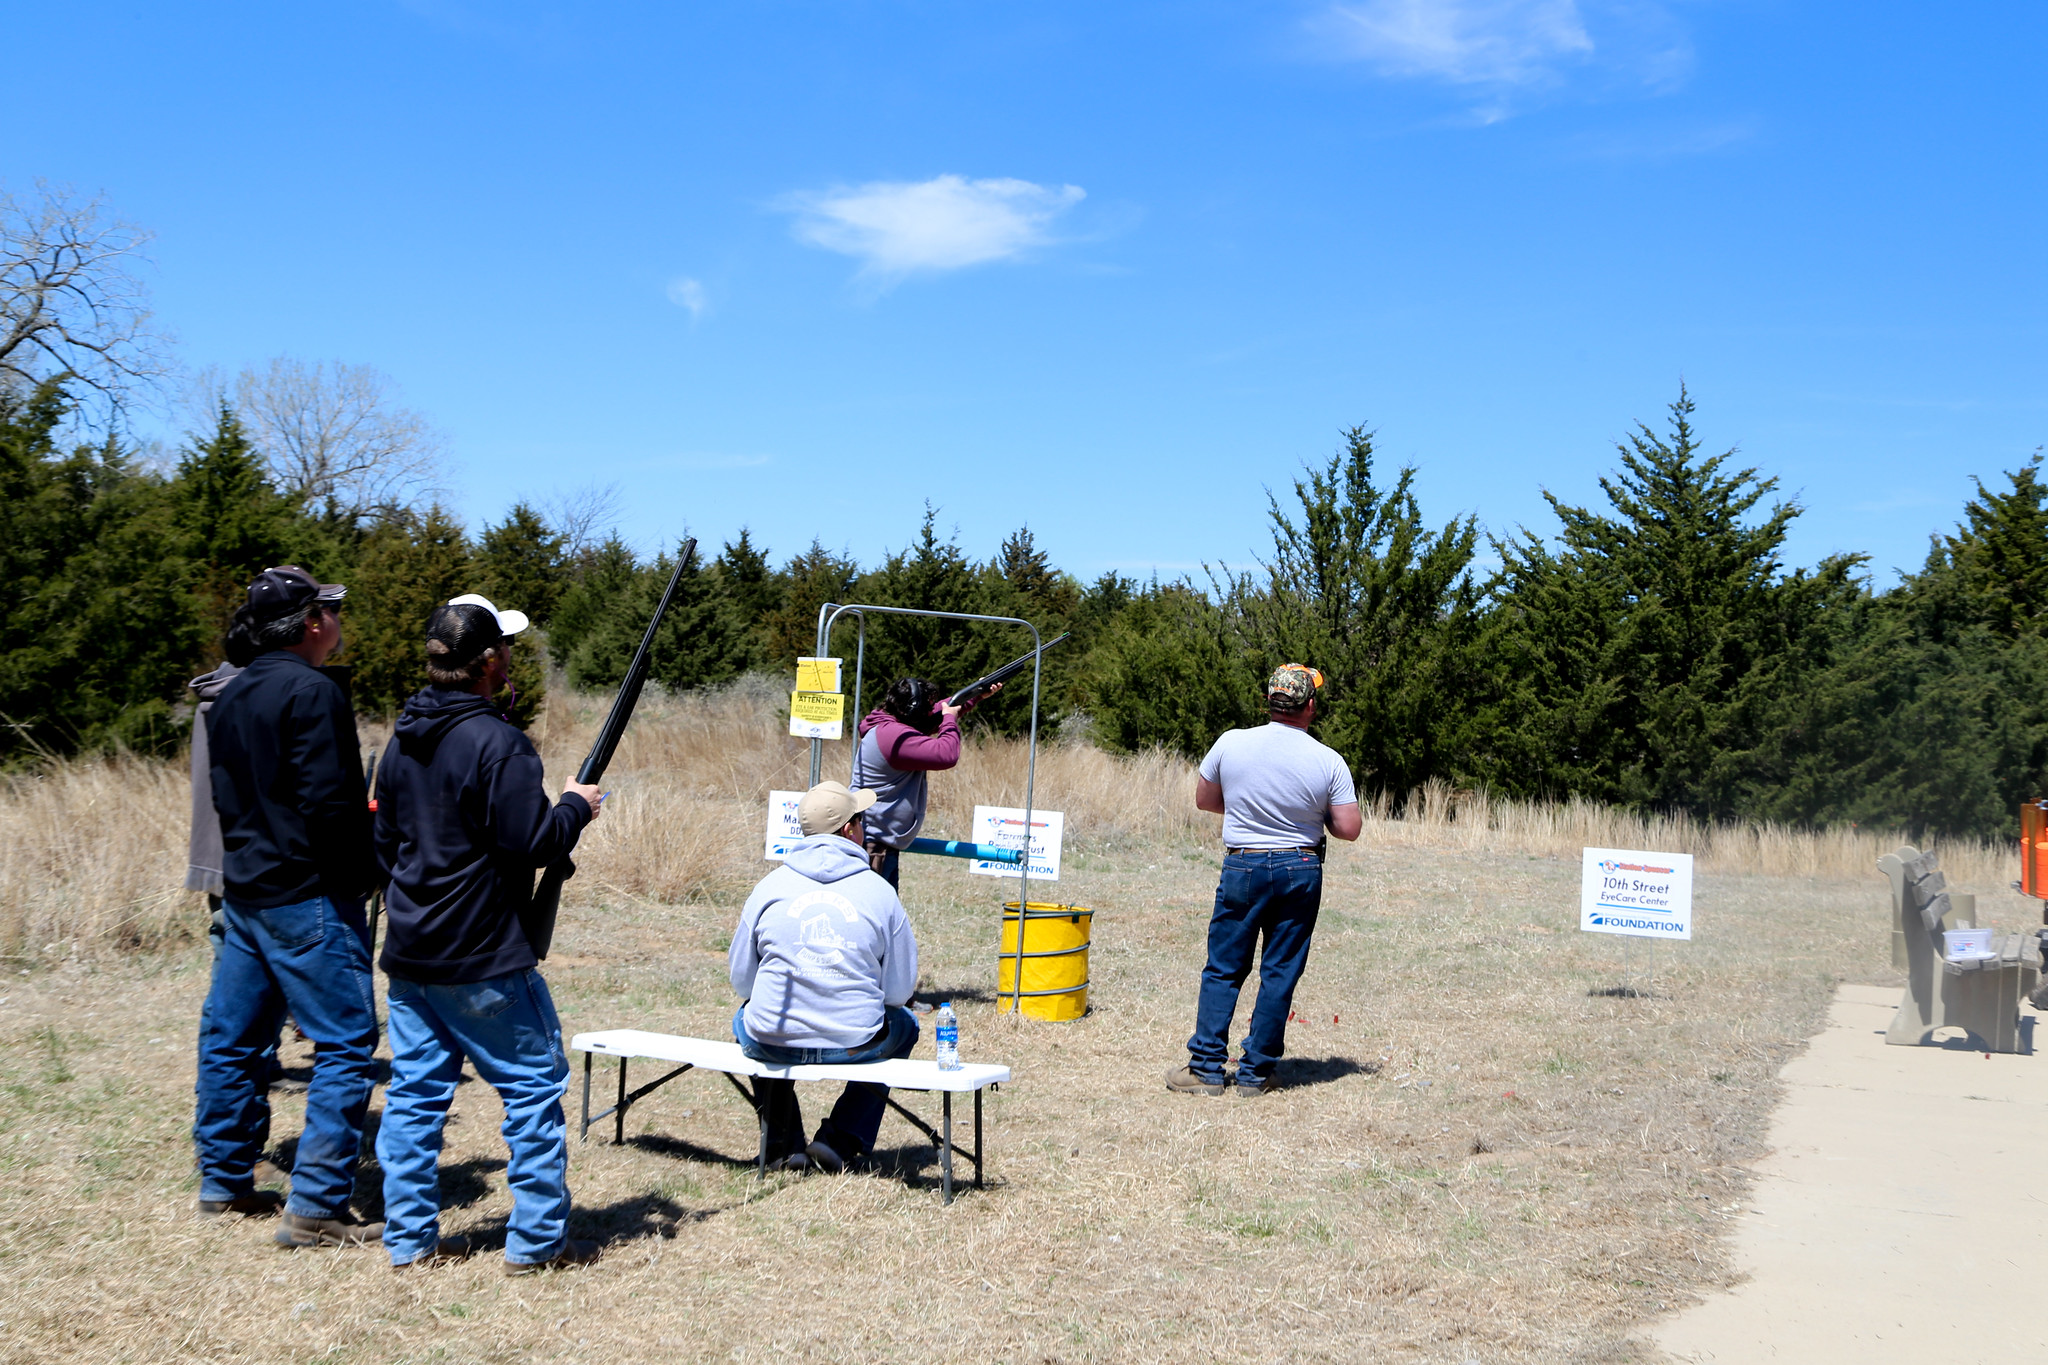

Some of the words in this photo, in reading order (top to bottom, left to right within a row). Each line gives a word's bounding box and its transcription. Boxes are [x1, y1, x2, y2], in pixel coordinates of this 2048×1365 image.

[798, 695, 838, 705] ATTENTION
[783, 814, 800, 824] Ma
[790, 826, 804, 835] DD
[1603, 877, 1629, 890] 10th
[1632, 880, 1669, 894] Street
[792, 892, 855, 917] MYERS
[1600, 891, 1637, 903] EyeCare
[1639, 895, 1669, 906] Center
[1604, 917, 1684, 932] FOUNDATION
